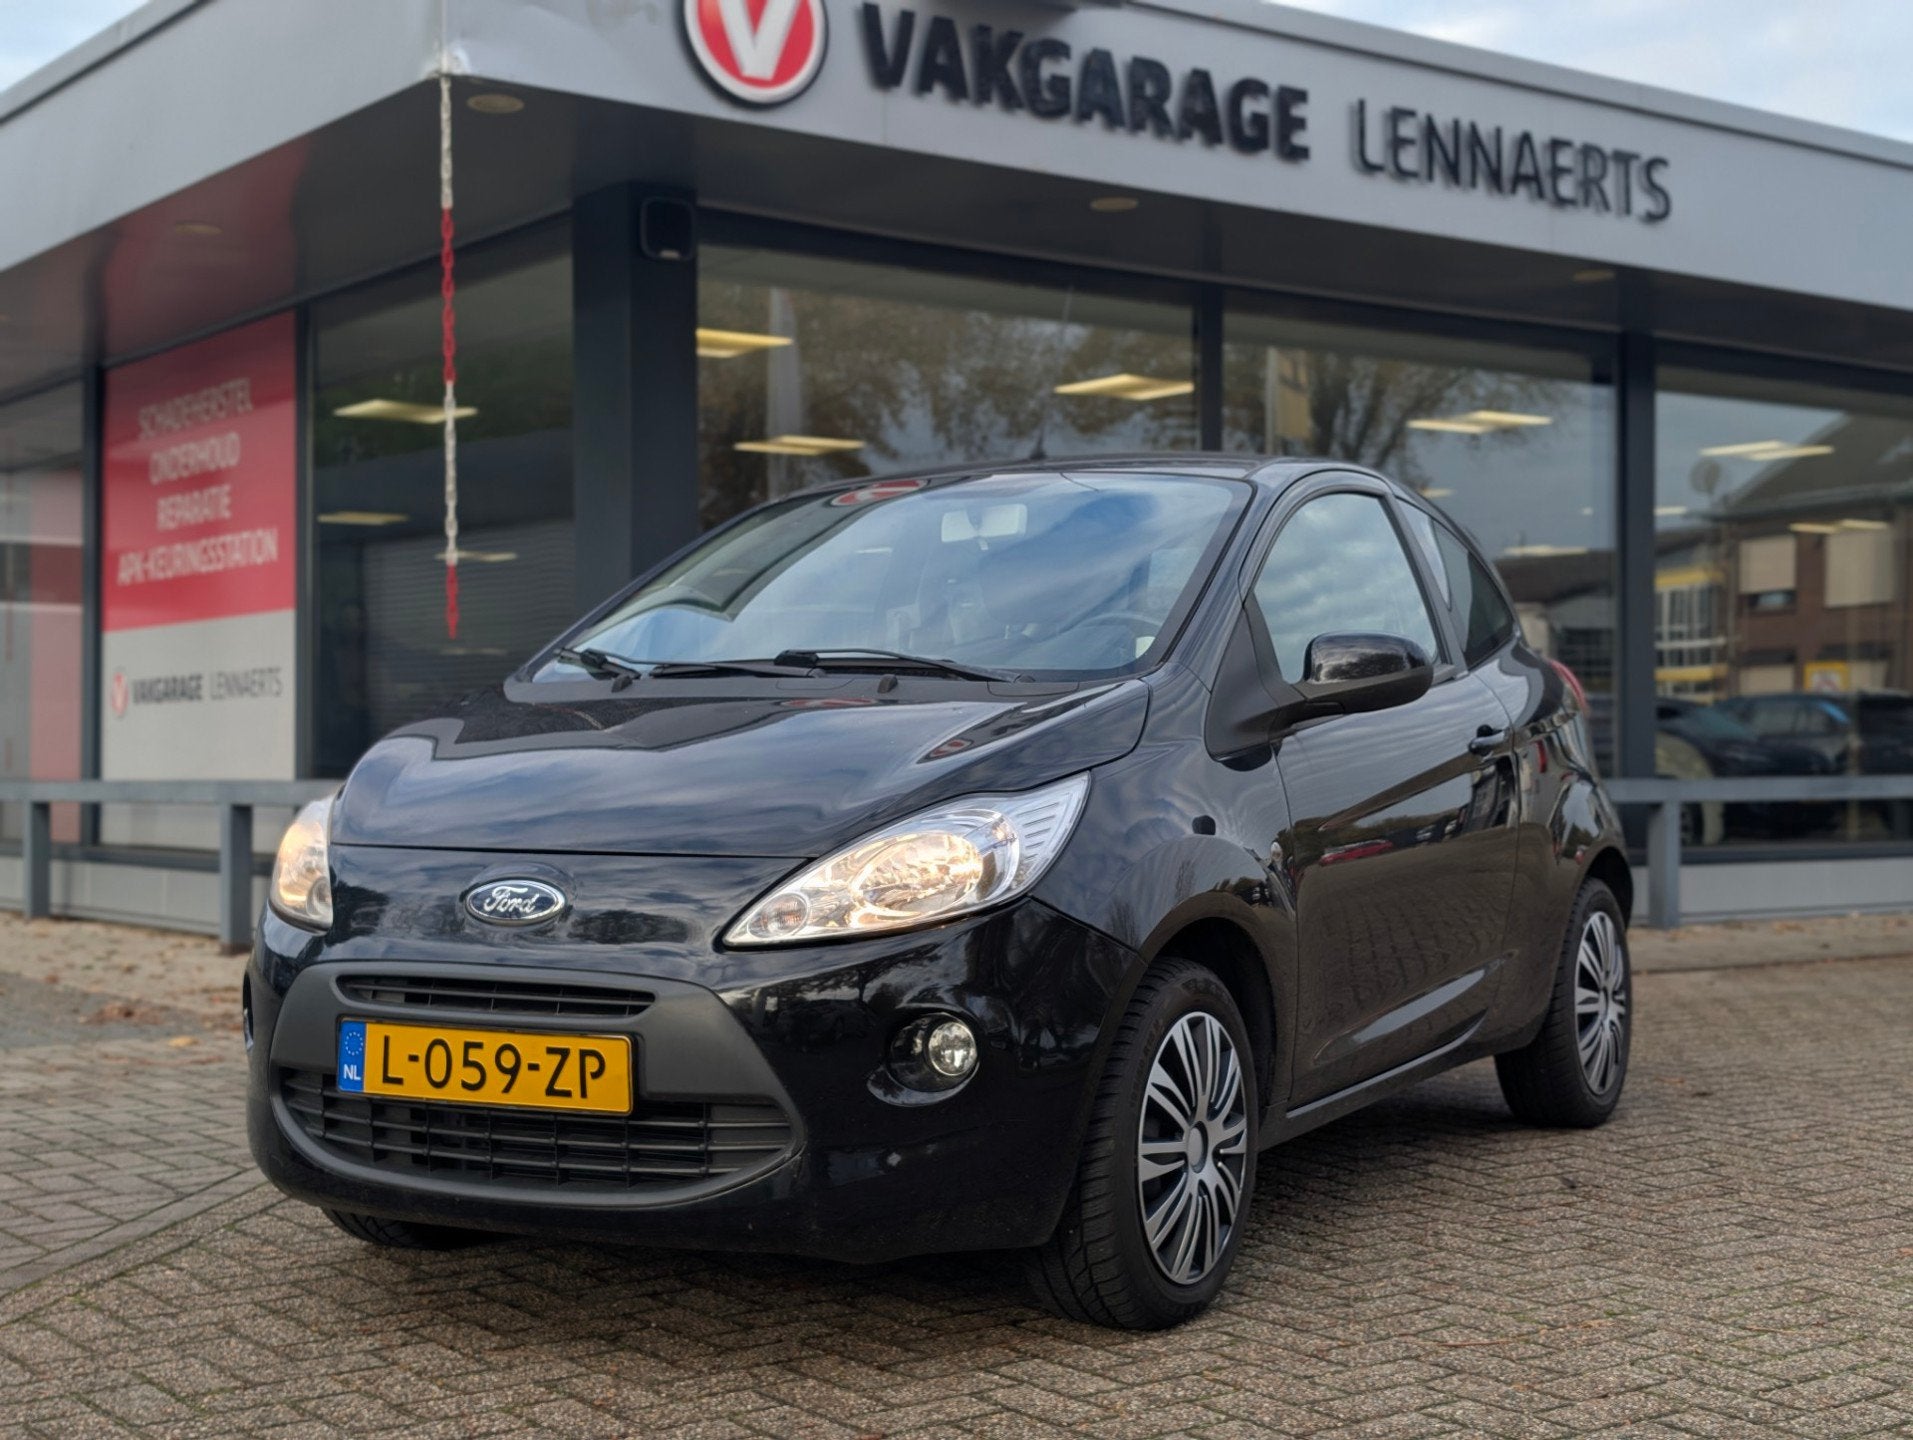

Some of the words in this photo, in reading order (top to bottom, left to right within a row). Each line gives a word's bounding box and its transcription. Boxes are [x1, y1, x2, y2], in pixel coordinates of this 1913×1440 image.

[860, 2, 1311, 161] VAKGARAGE
[1351, 97, 1672, 224] LENNAERTS
[149, 430, 240, 485] ONDERHOUD
[156, 484, 232, 531] REPARATIE
[132, 673, 203, 704] VAKGARAGE
[209, 666, 284, 701] LENNAERTS
[483, 886, 541, 914] Ford
[343, 1064, 361, 1081] NL
[382, 1034, 607, 1099] L-059-ZP
